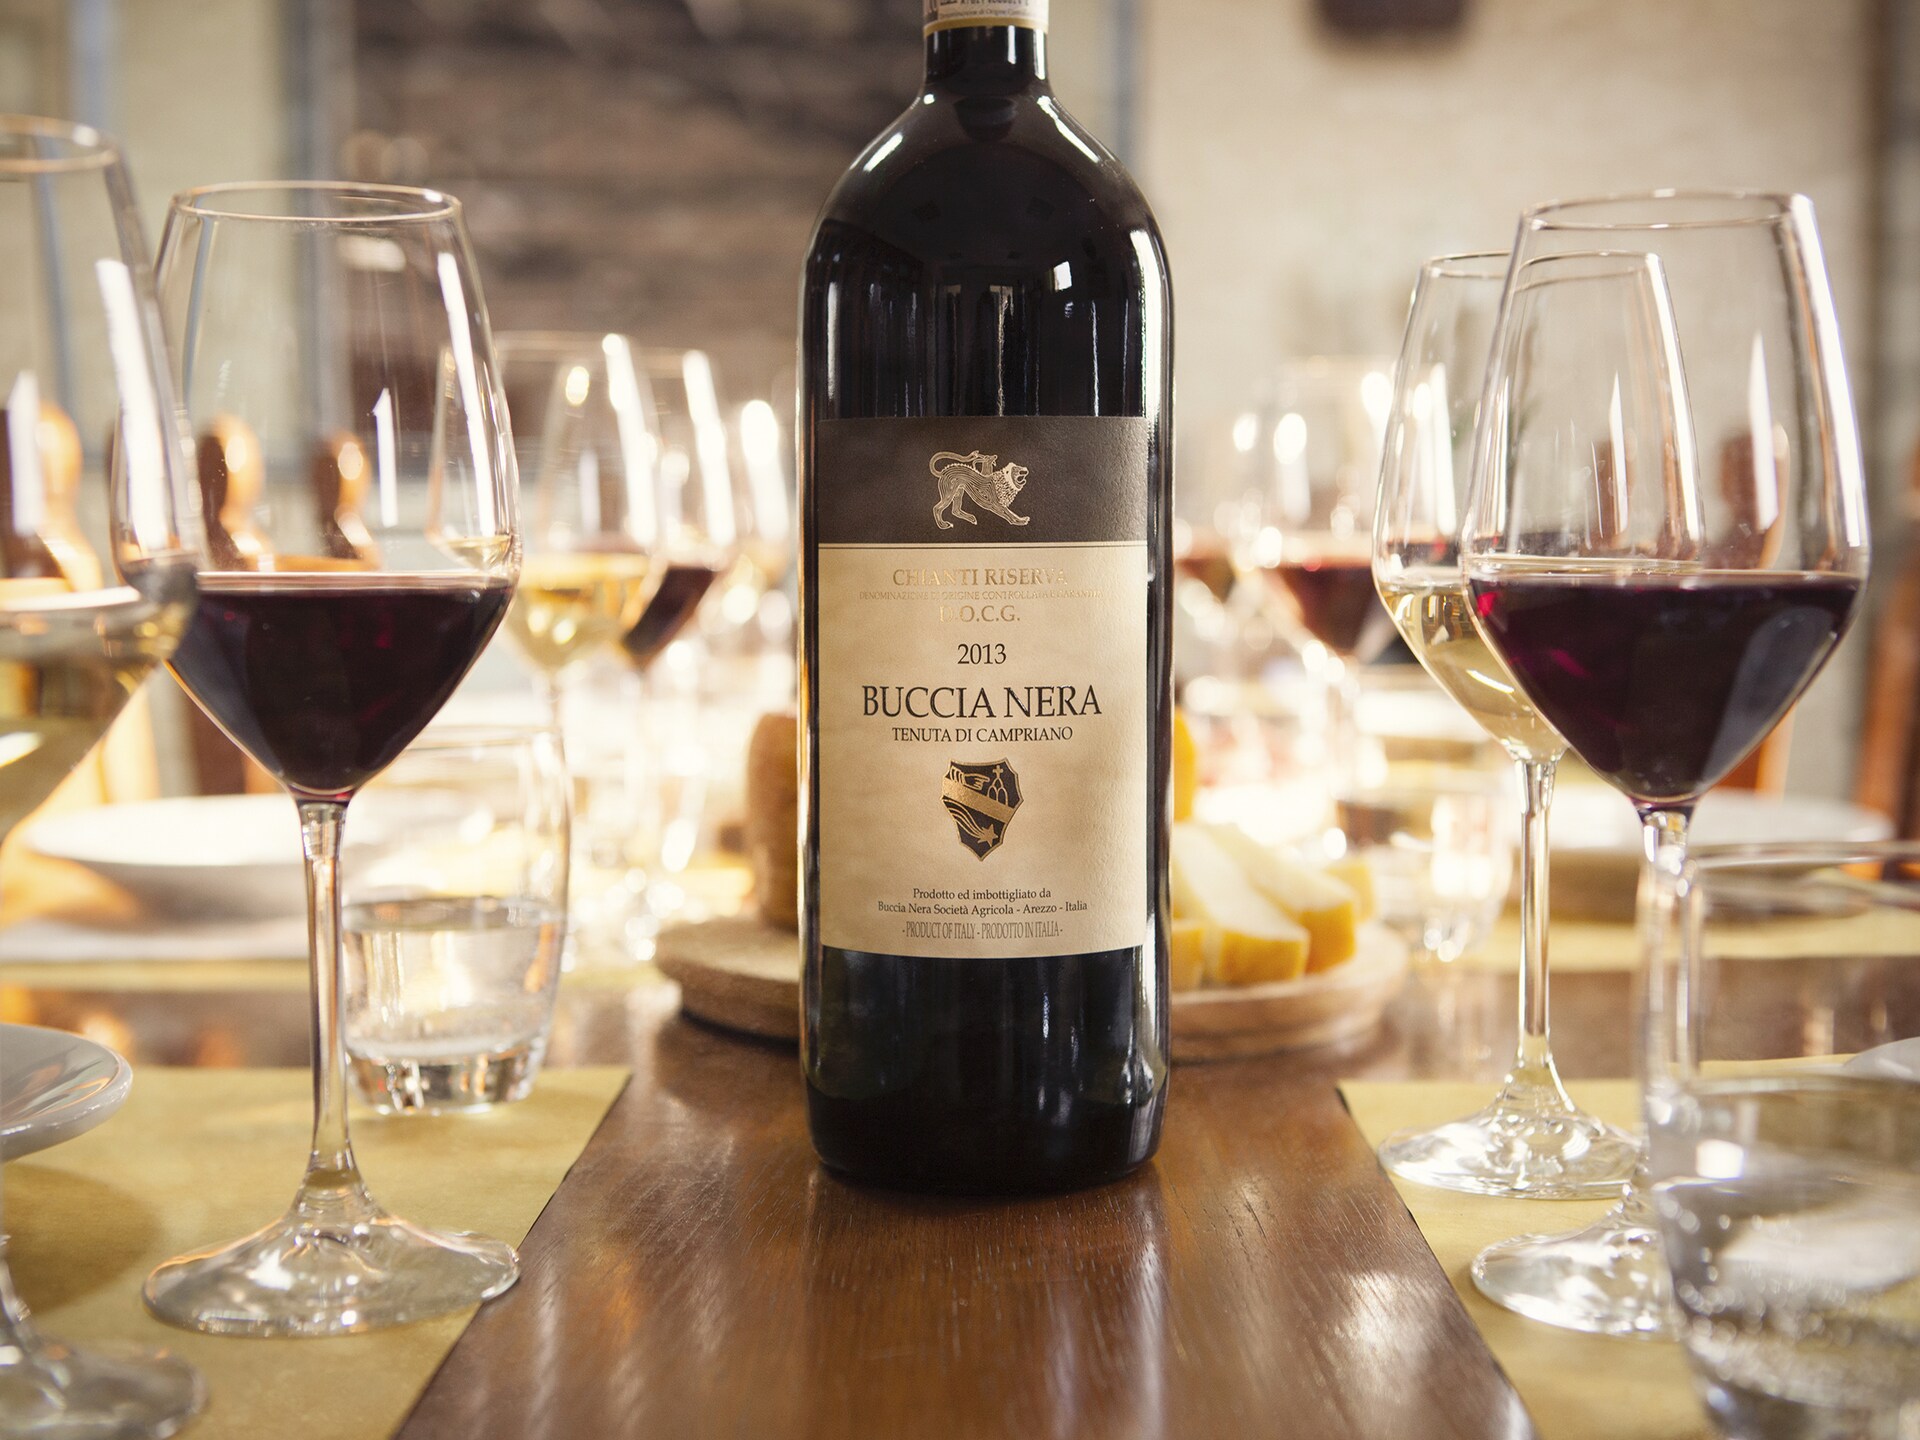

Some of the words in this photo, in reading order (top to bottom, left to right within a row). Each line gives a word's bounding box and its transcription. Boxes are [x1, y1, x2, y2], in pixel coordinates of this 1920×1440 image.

[892, 568, 979, 587] CHIANTI
[983, 567, 1068, 586] RISERVA
[956, 642, 1007, 665] 2013
[862, 685, 997, 719] BUCCIA
[1003, 684, 1103, 718] NERA
[892, 727, 952, 742] TENUTA
[955, 728, 972, 742] DI
[976, 726, 1073, 742] CAMPRIANO
[913, 887, 955, 900] Prodotto
[957, 889, 970, 900] ed
[972, 888, 1037, 903] imbottigliato
[1039, 887, 1051, 898] da
[878, 900, 906, 913] Buccia
[908, 903, 932, 914] Nera
[934, 903, 969, 915] Società
[971, 904, 1014, 918] Agricola
[1023, 903, 1057, 914] Arezzo
[1065, 900, 1088, 912] Italia
[942, 922, 953, 939] OF
[981, 922, 1024, 939] PRODOTTO
[1025, 921, 1034, 938] IN
